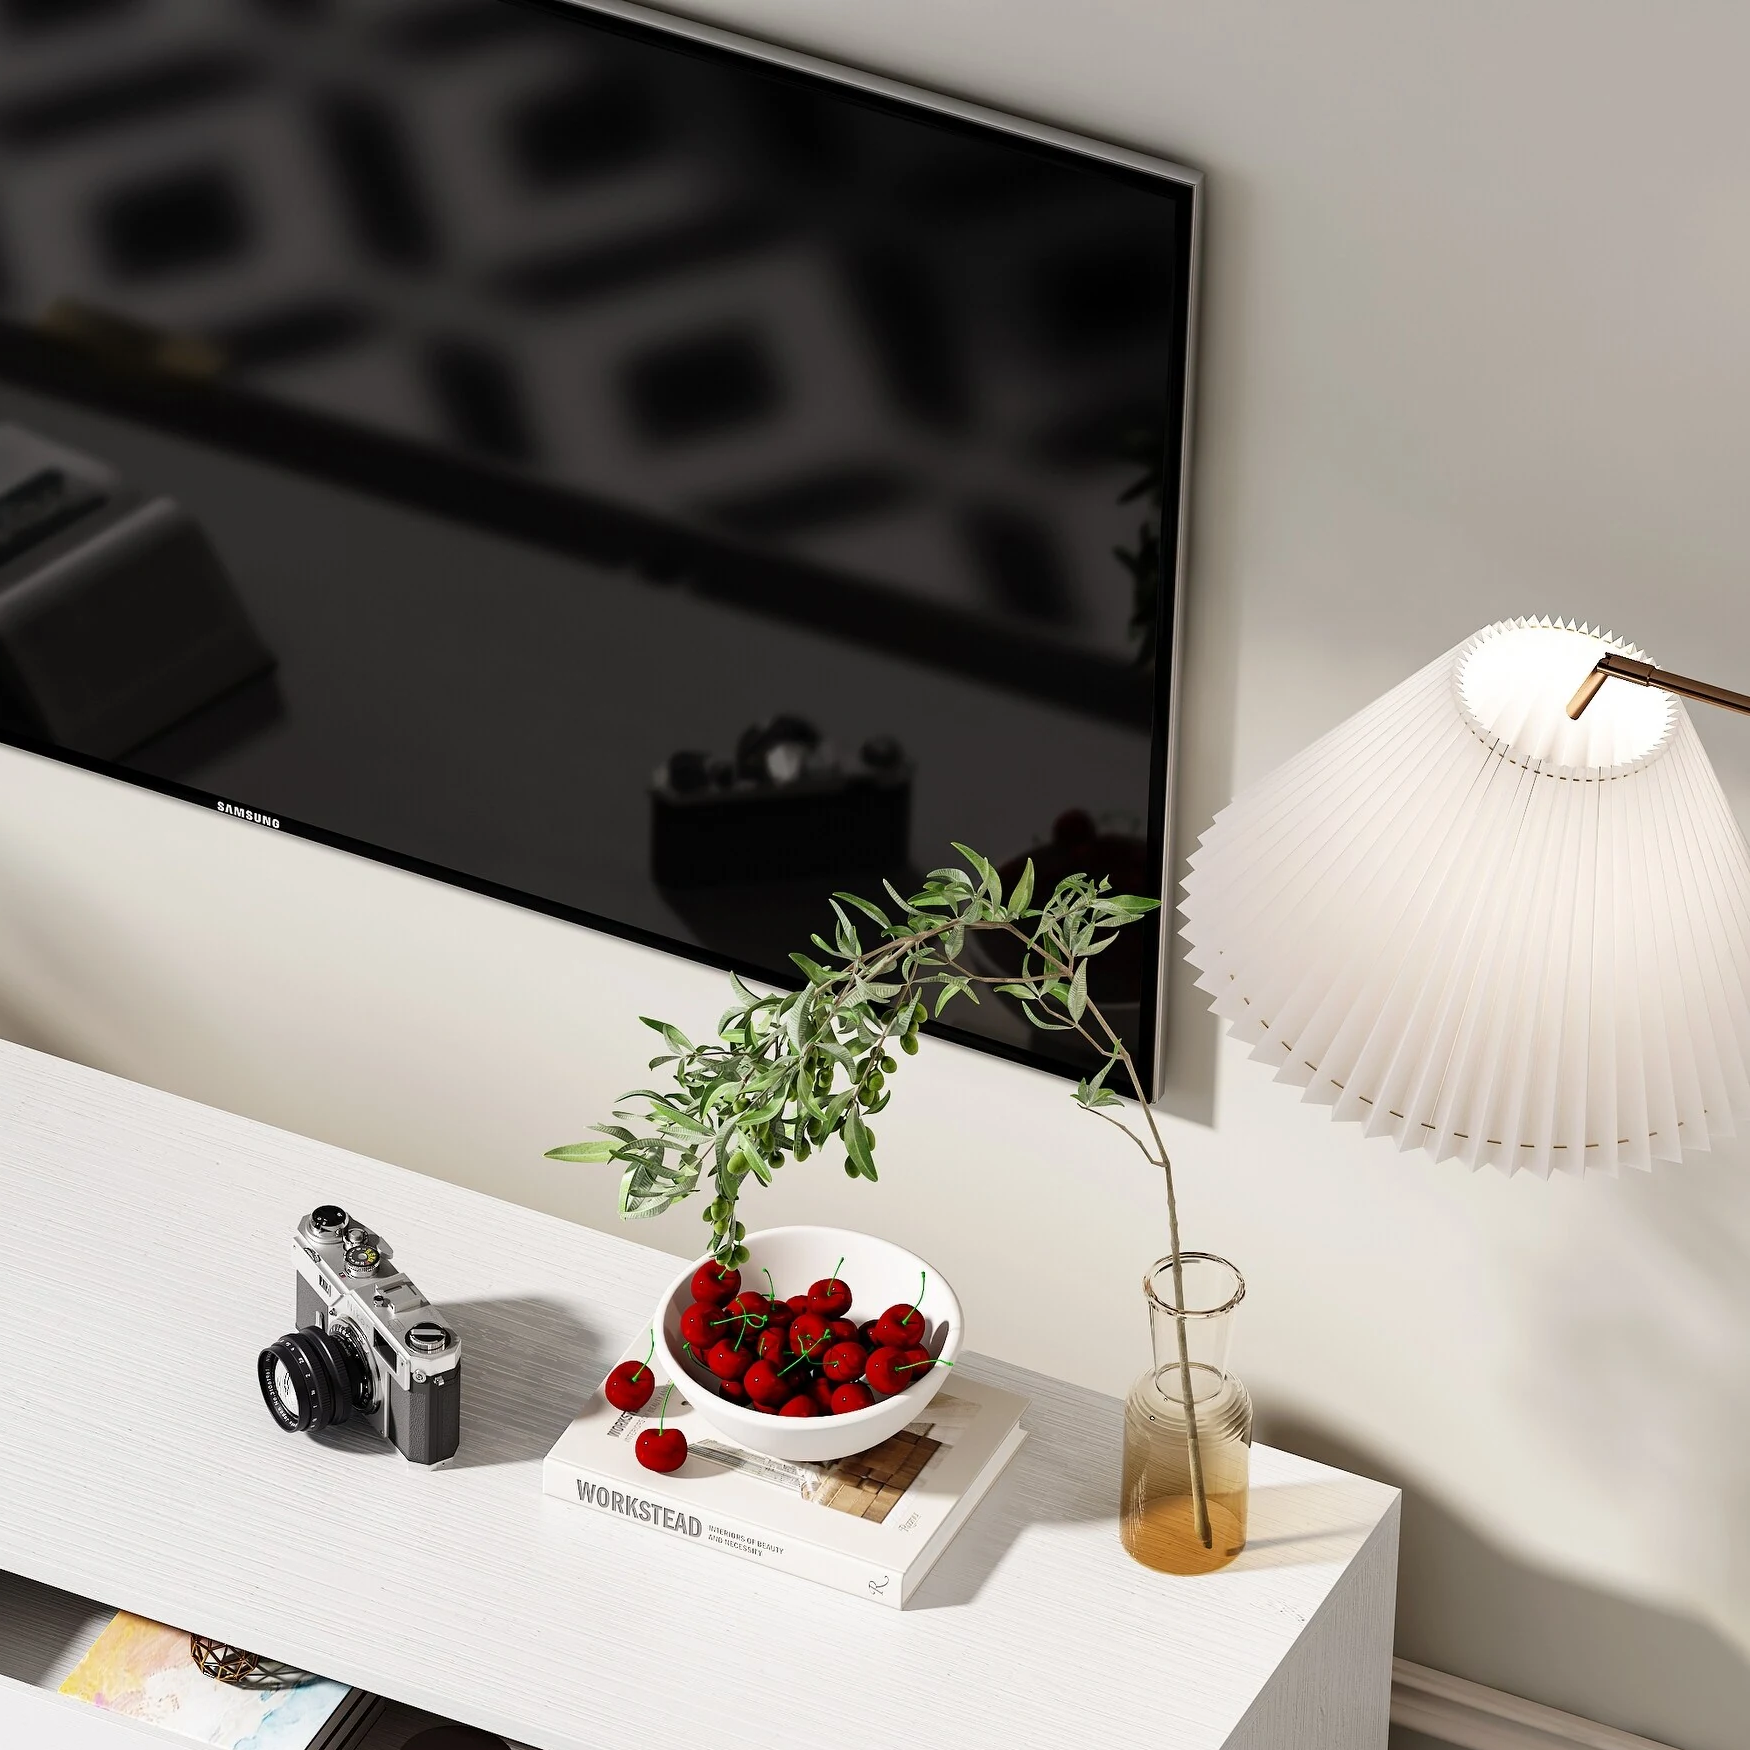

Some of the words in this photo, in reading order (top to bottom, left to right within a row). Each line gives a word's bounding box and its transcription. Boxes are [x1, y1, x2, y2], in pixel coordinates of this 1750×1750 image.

[217, 801, 280, 829] SAMSUNG
[576, 1479, 702, 1538] WORKSTEAD
[708, 1524, 746, 1543] INTERIORS
[747, 1537, 755, 1546] OF
[757, 1540, 784, 1555] BEAUTY
[708, 1534, 723, 1544] AND
[724, 1538, 763, 1557] NECESSITY
